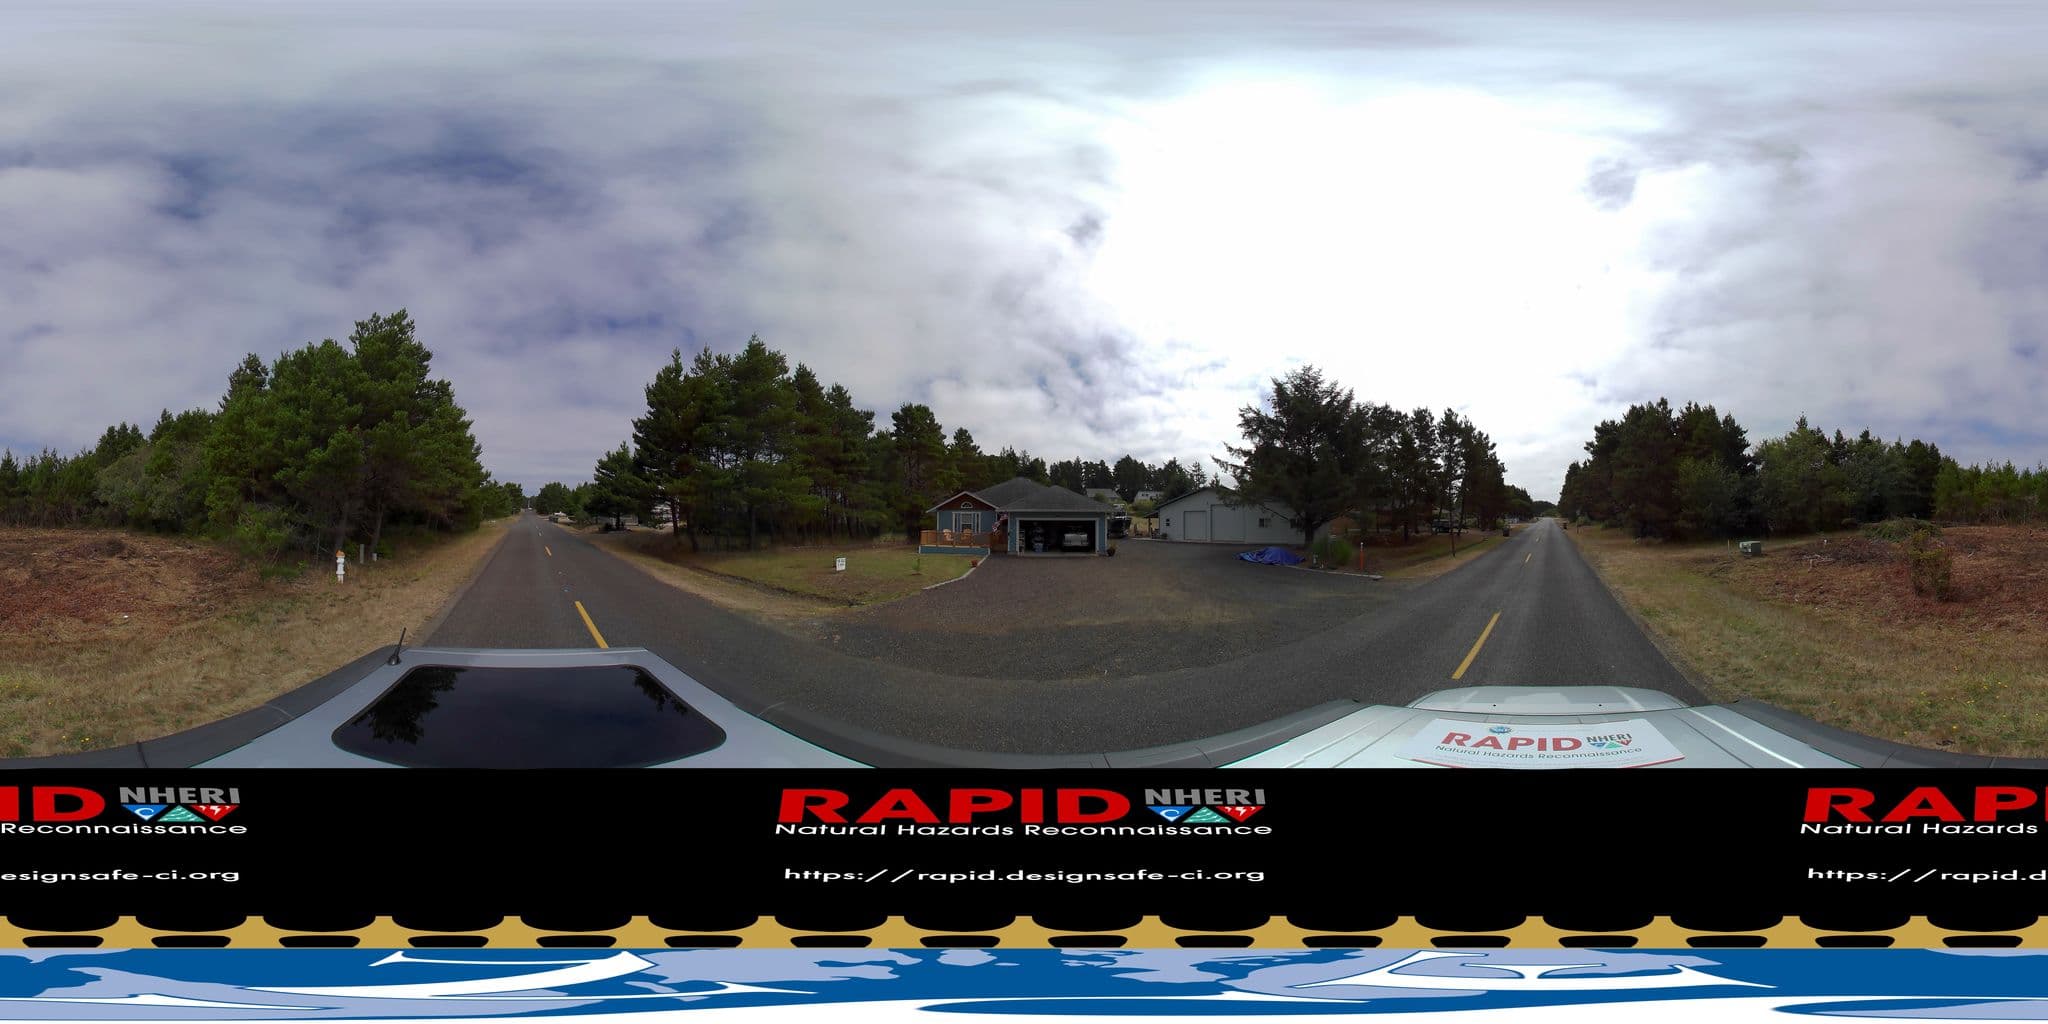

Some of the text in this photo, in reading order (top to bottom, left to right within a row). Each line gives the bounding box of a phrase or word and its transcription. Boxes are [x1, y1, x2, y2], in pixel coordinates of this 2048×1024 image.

[1441, 732, 1582, 751] RAPID
[1586, 733, 1632, 743] NHERI
[1435, 745, 1642, 759] Natural Hazards Reconnaissance
